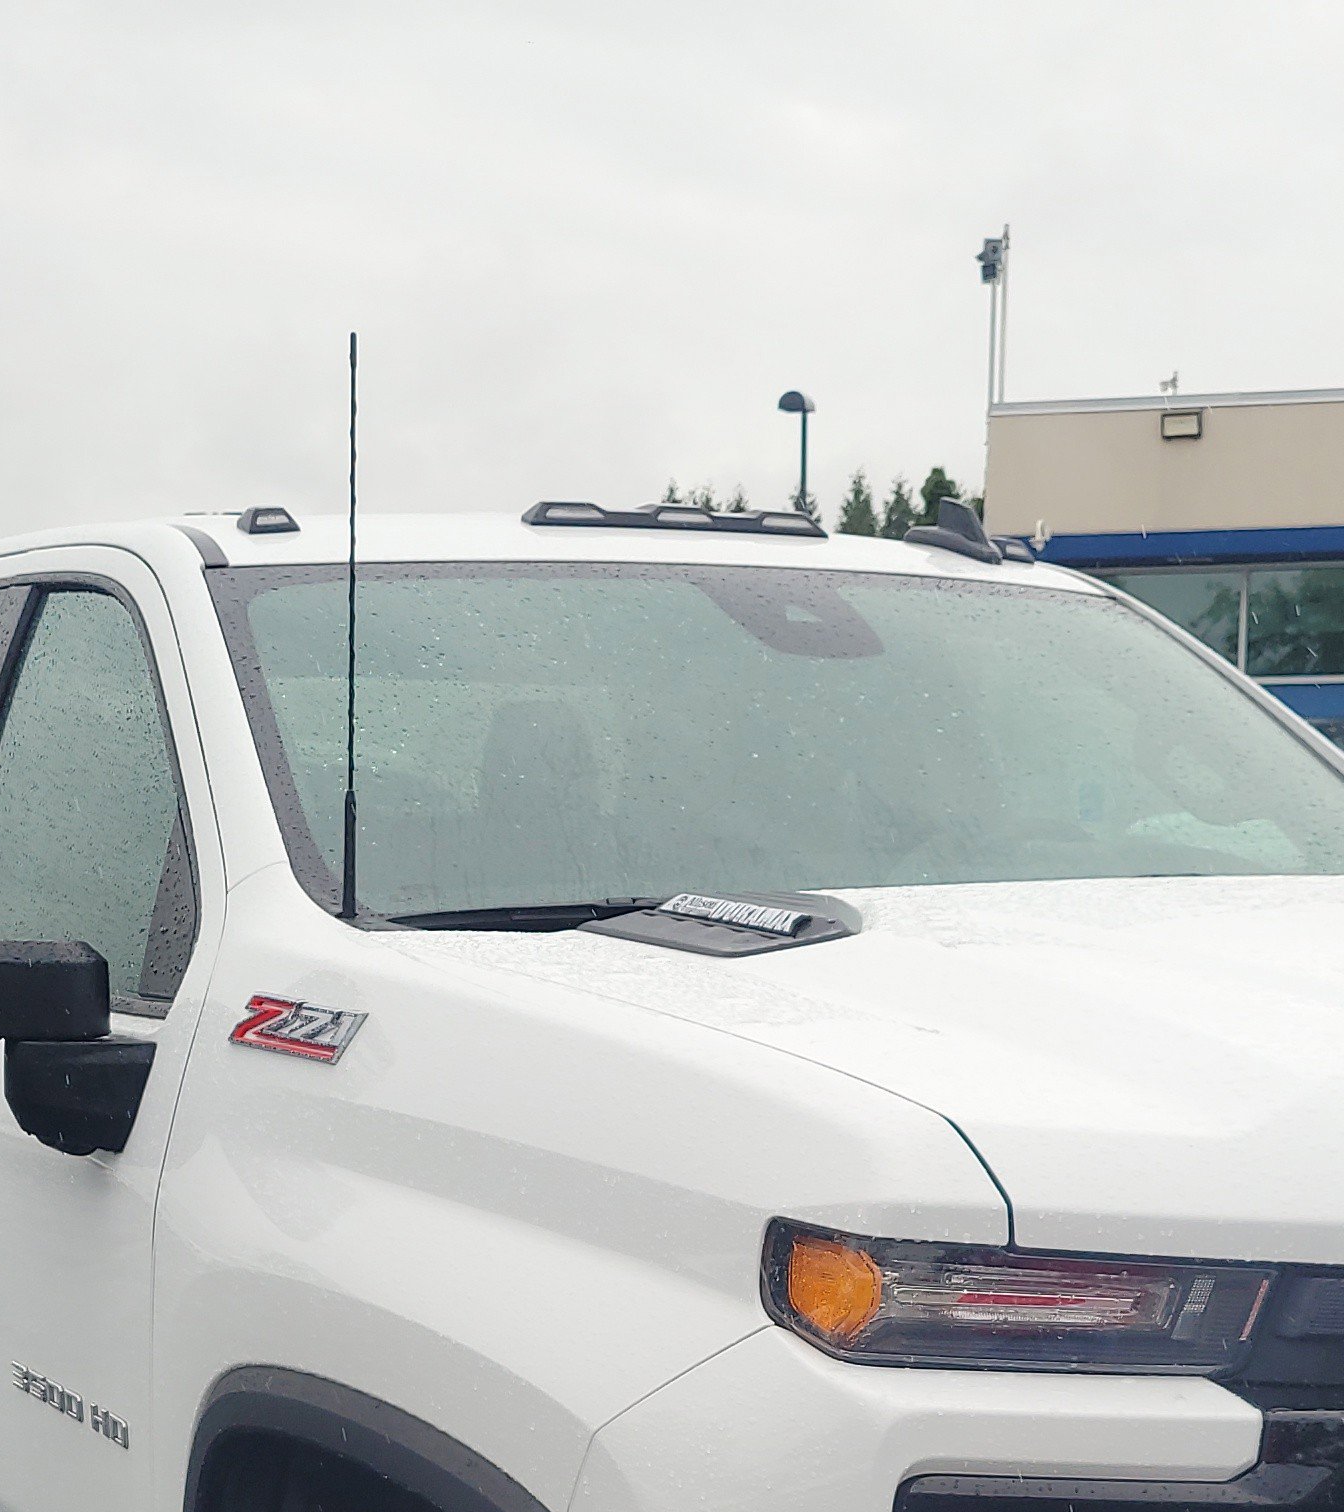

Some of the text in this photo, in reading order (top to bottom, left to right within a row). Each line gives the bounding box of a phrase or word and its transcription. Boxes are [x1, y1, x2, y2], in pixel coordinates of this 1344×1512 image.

[709, 901, 805, 933] DURAMAX
[228, 990, 369, 1065] Z71
[11, 1360, 129, 1450] 3500 HD
